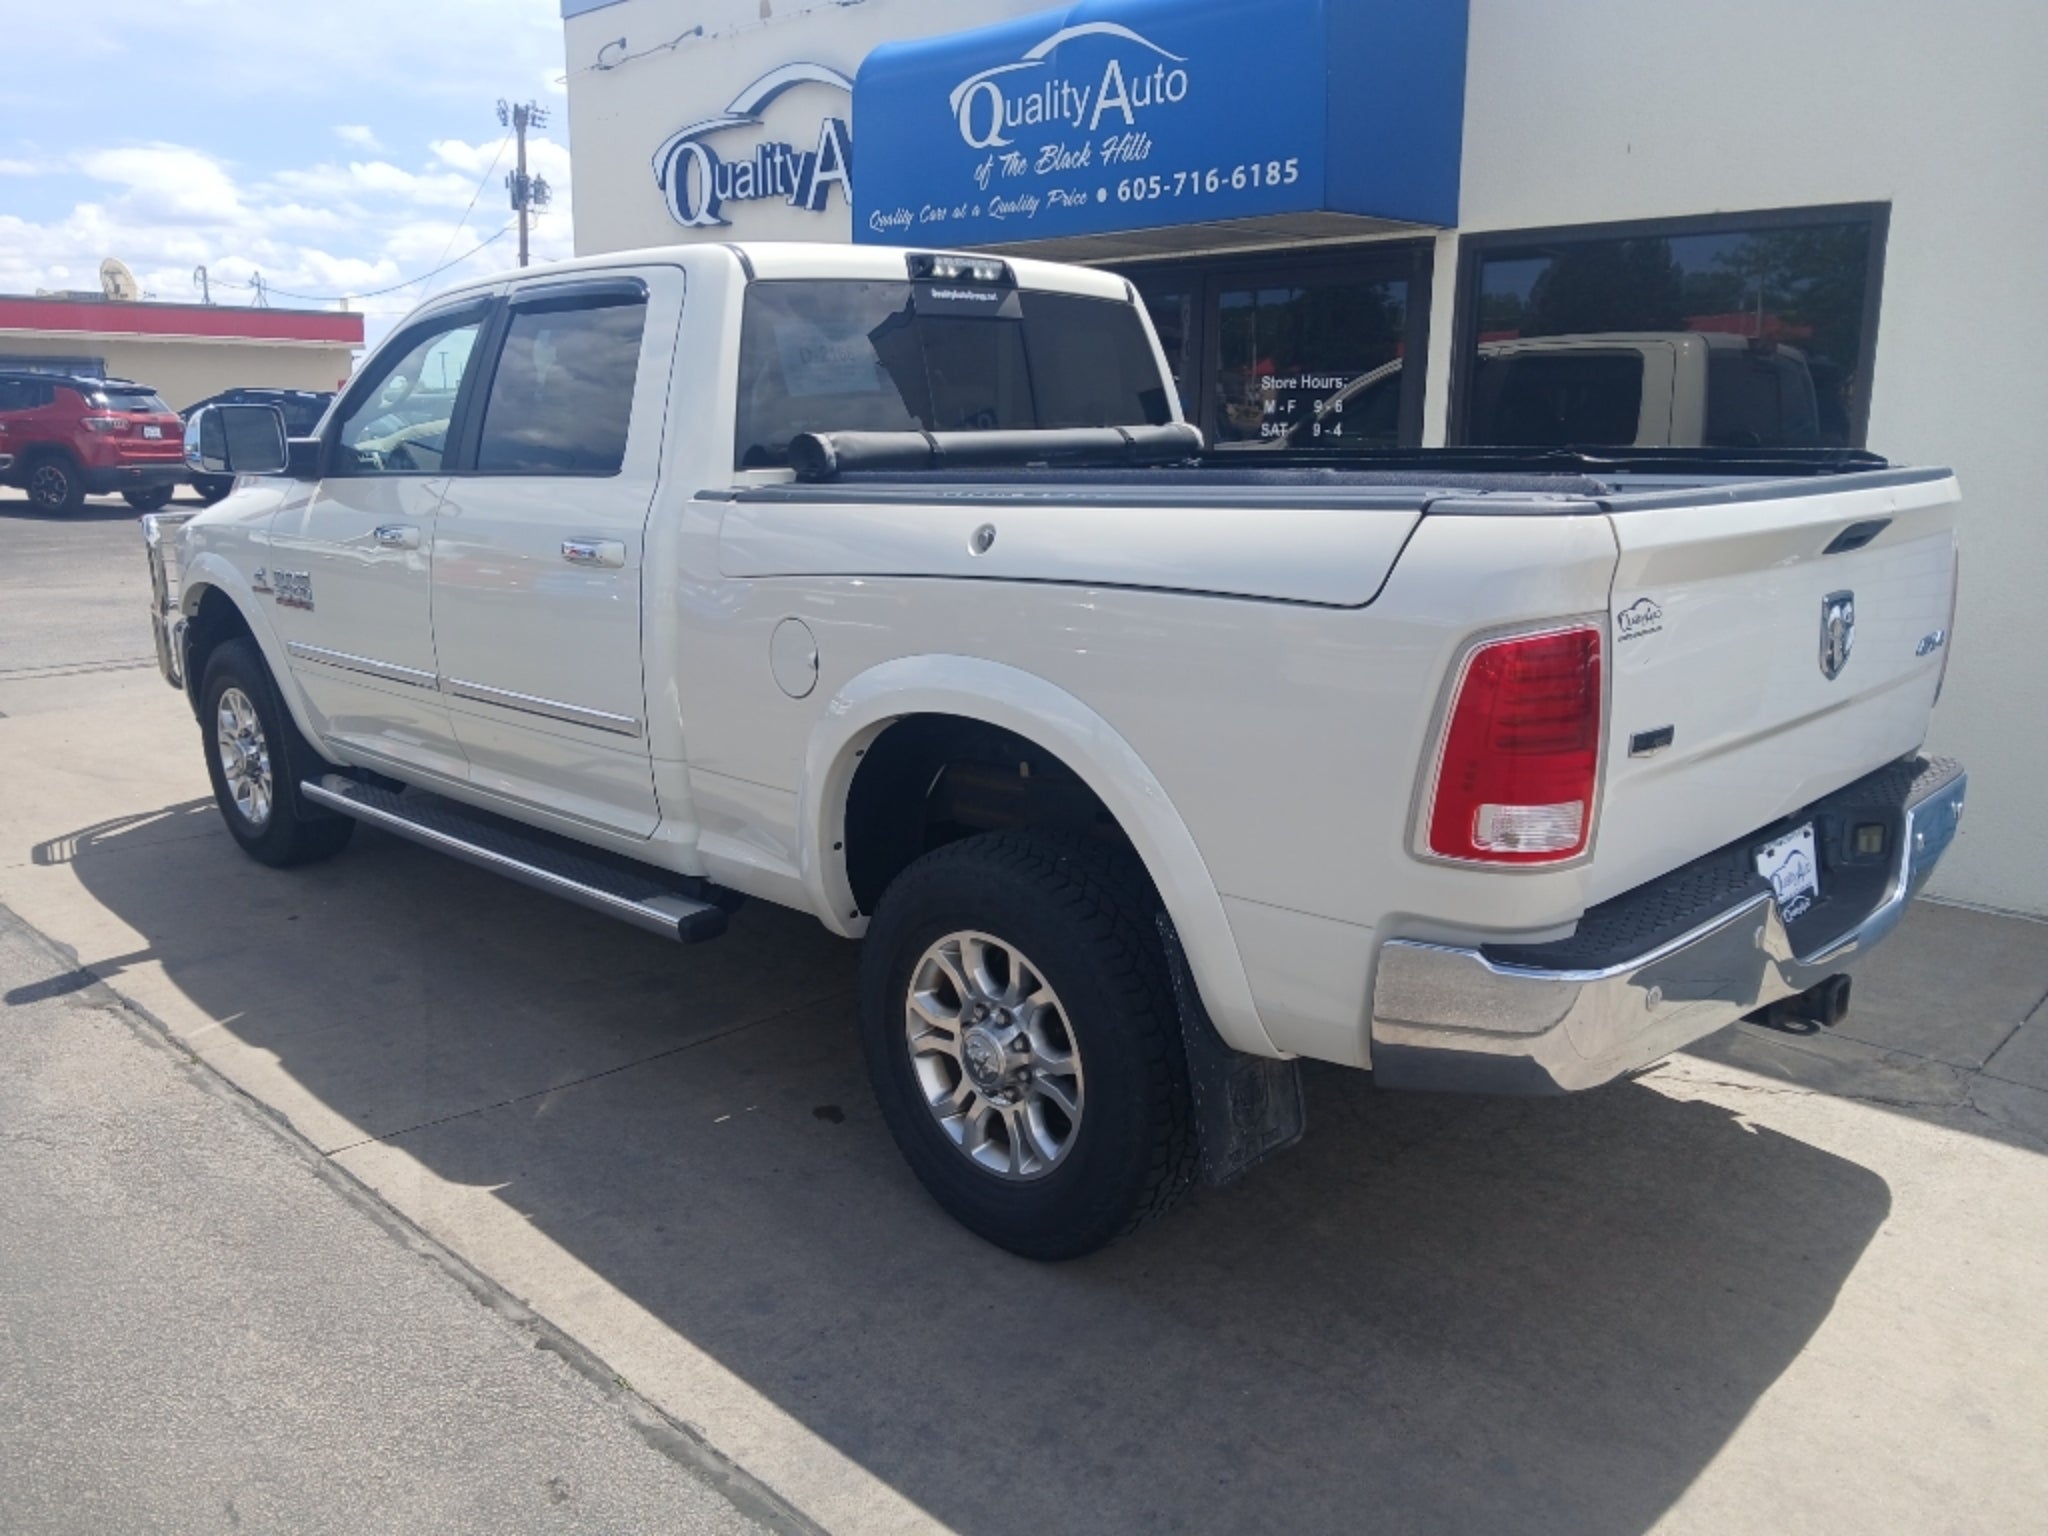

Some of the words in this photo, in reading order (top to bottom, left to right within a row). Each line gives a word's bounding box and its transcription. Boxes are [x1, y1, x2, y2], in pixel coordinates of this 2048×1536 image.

[974, 154, 994, 191] of
[999, 150, 1028, 178] The
[1034, 140, 1092, 174] Black
[1100, 131, 1152, 167] Hills
[869, 207, 914, 232] Quality
[952, 203, 968, 219] at
[971, 205, 981, 217] a
[988, 194, 1040, 220] Quality
[1046, 188, 1088, 209] Price
[1117, 158, 1299, 202] 605-716-6185
[1261, 375, 1297, 390] Store
[1301, 374, 1349, 389] Hours:
[1287, 400, 1296, 413] F
[1313, 400, 1323, 413] 9
[1261, 423, 1288, 437] SAT
[1333, 421, 1343, 437] 4
